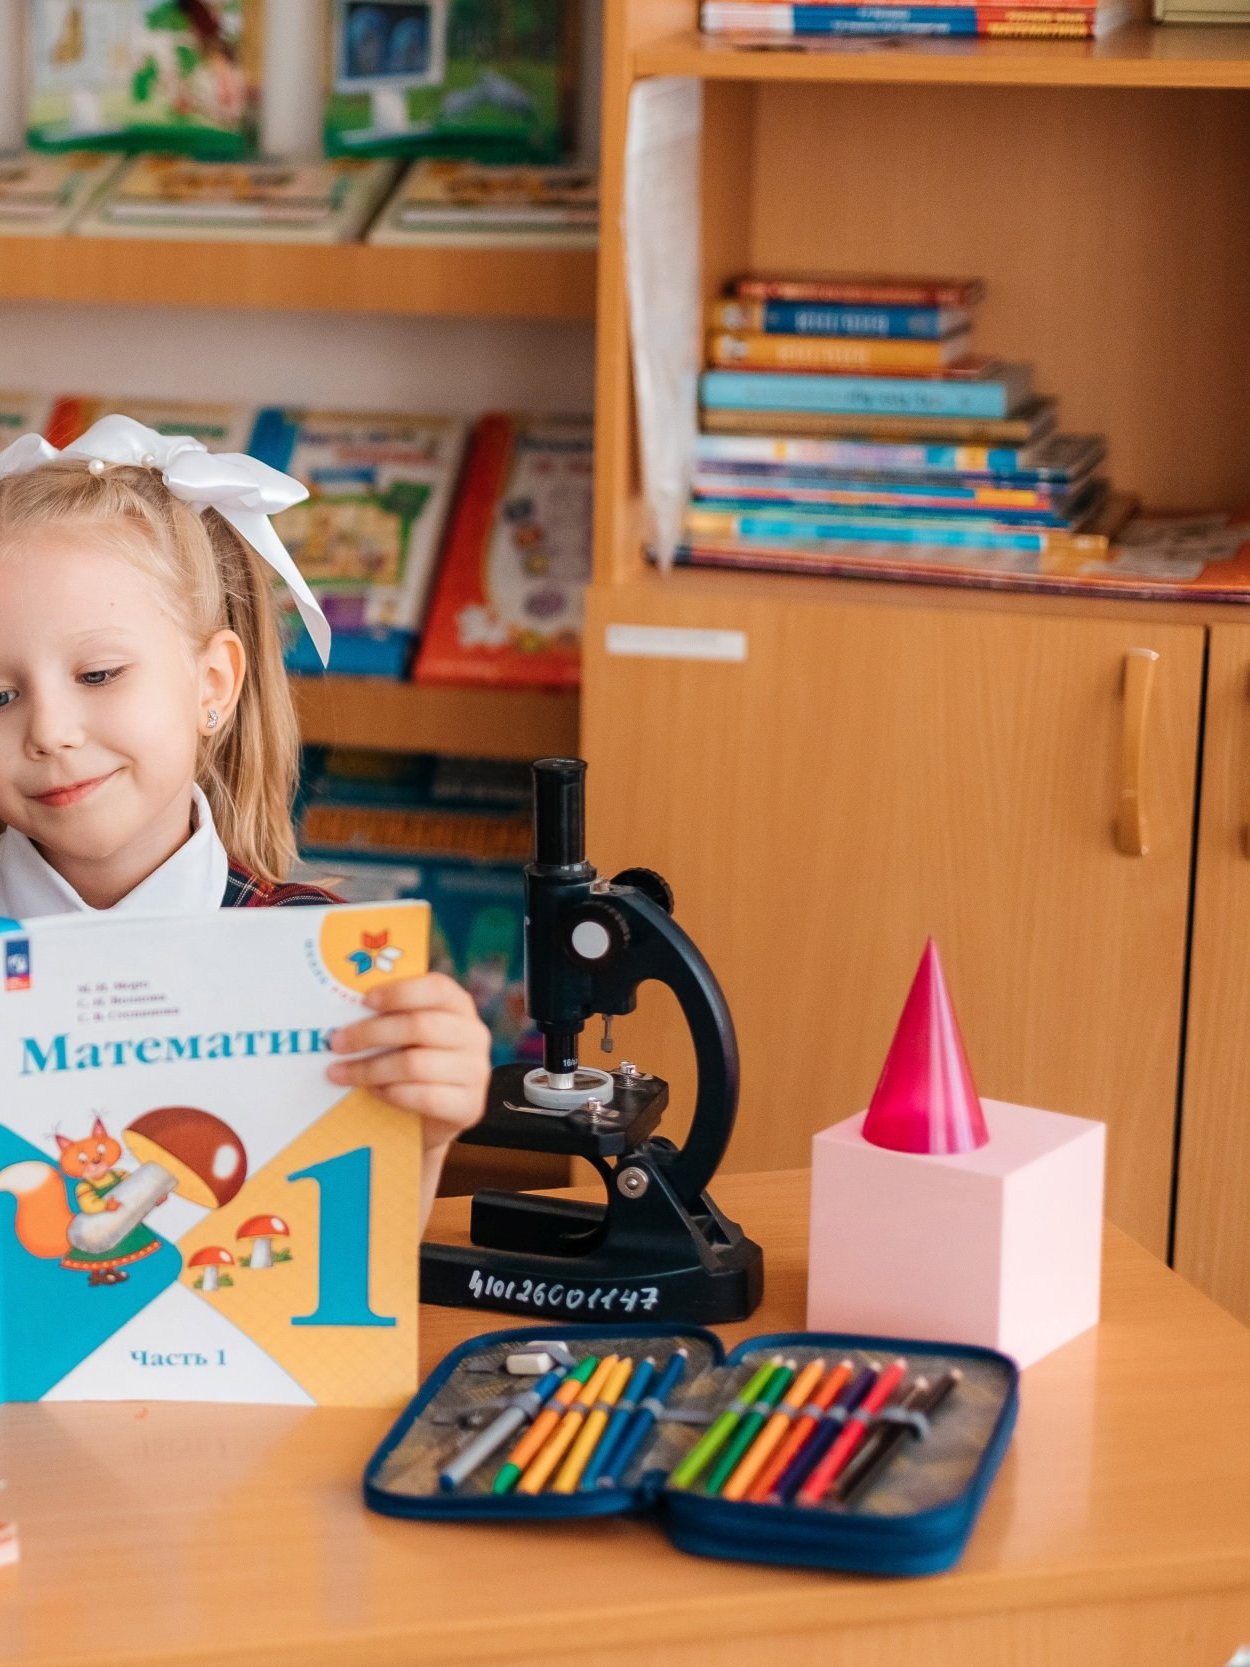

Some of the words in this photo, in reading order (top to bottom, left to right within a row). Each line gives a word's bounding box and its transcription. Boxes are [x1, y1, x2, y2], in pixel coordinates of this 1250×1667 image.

[19, 1026, 336, 1077] Математик
[287, 1146, 397, 1326] 1
[130, 1350, 208, 1366] Часть
